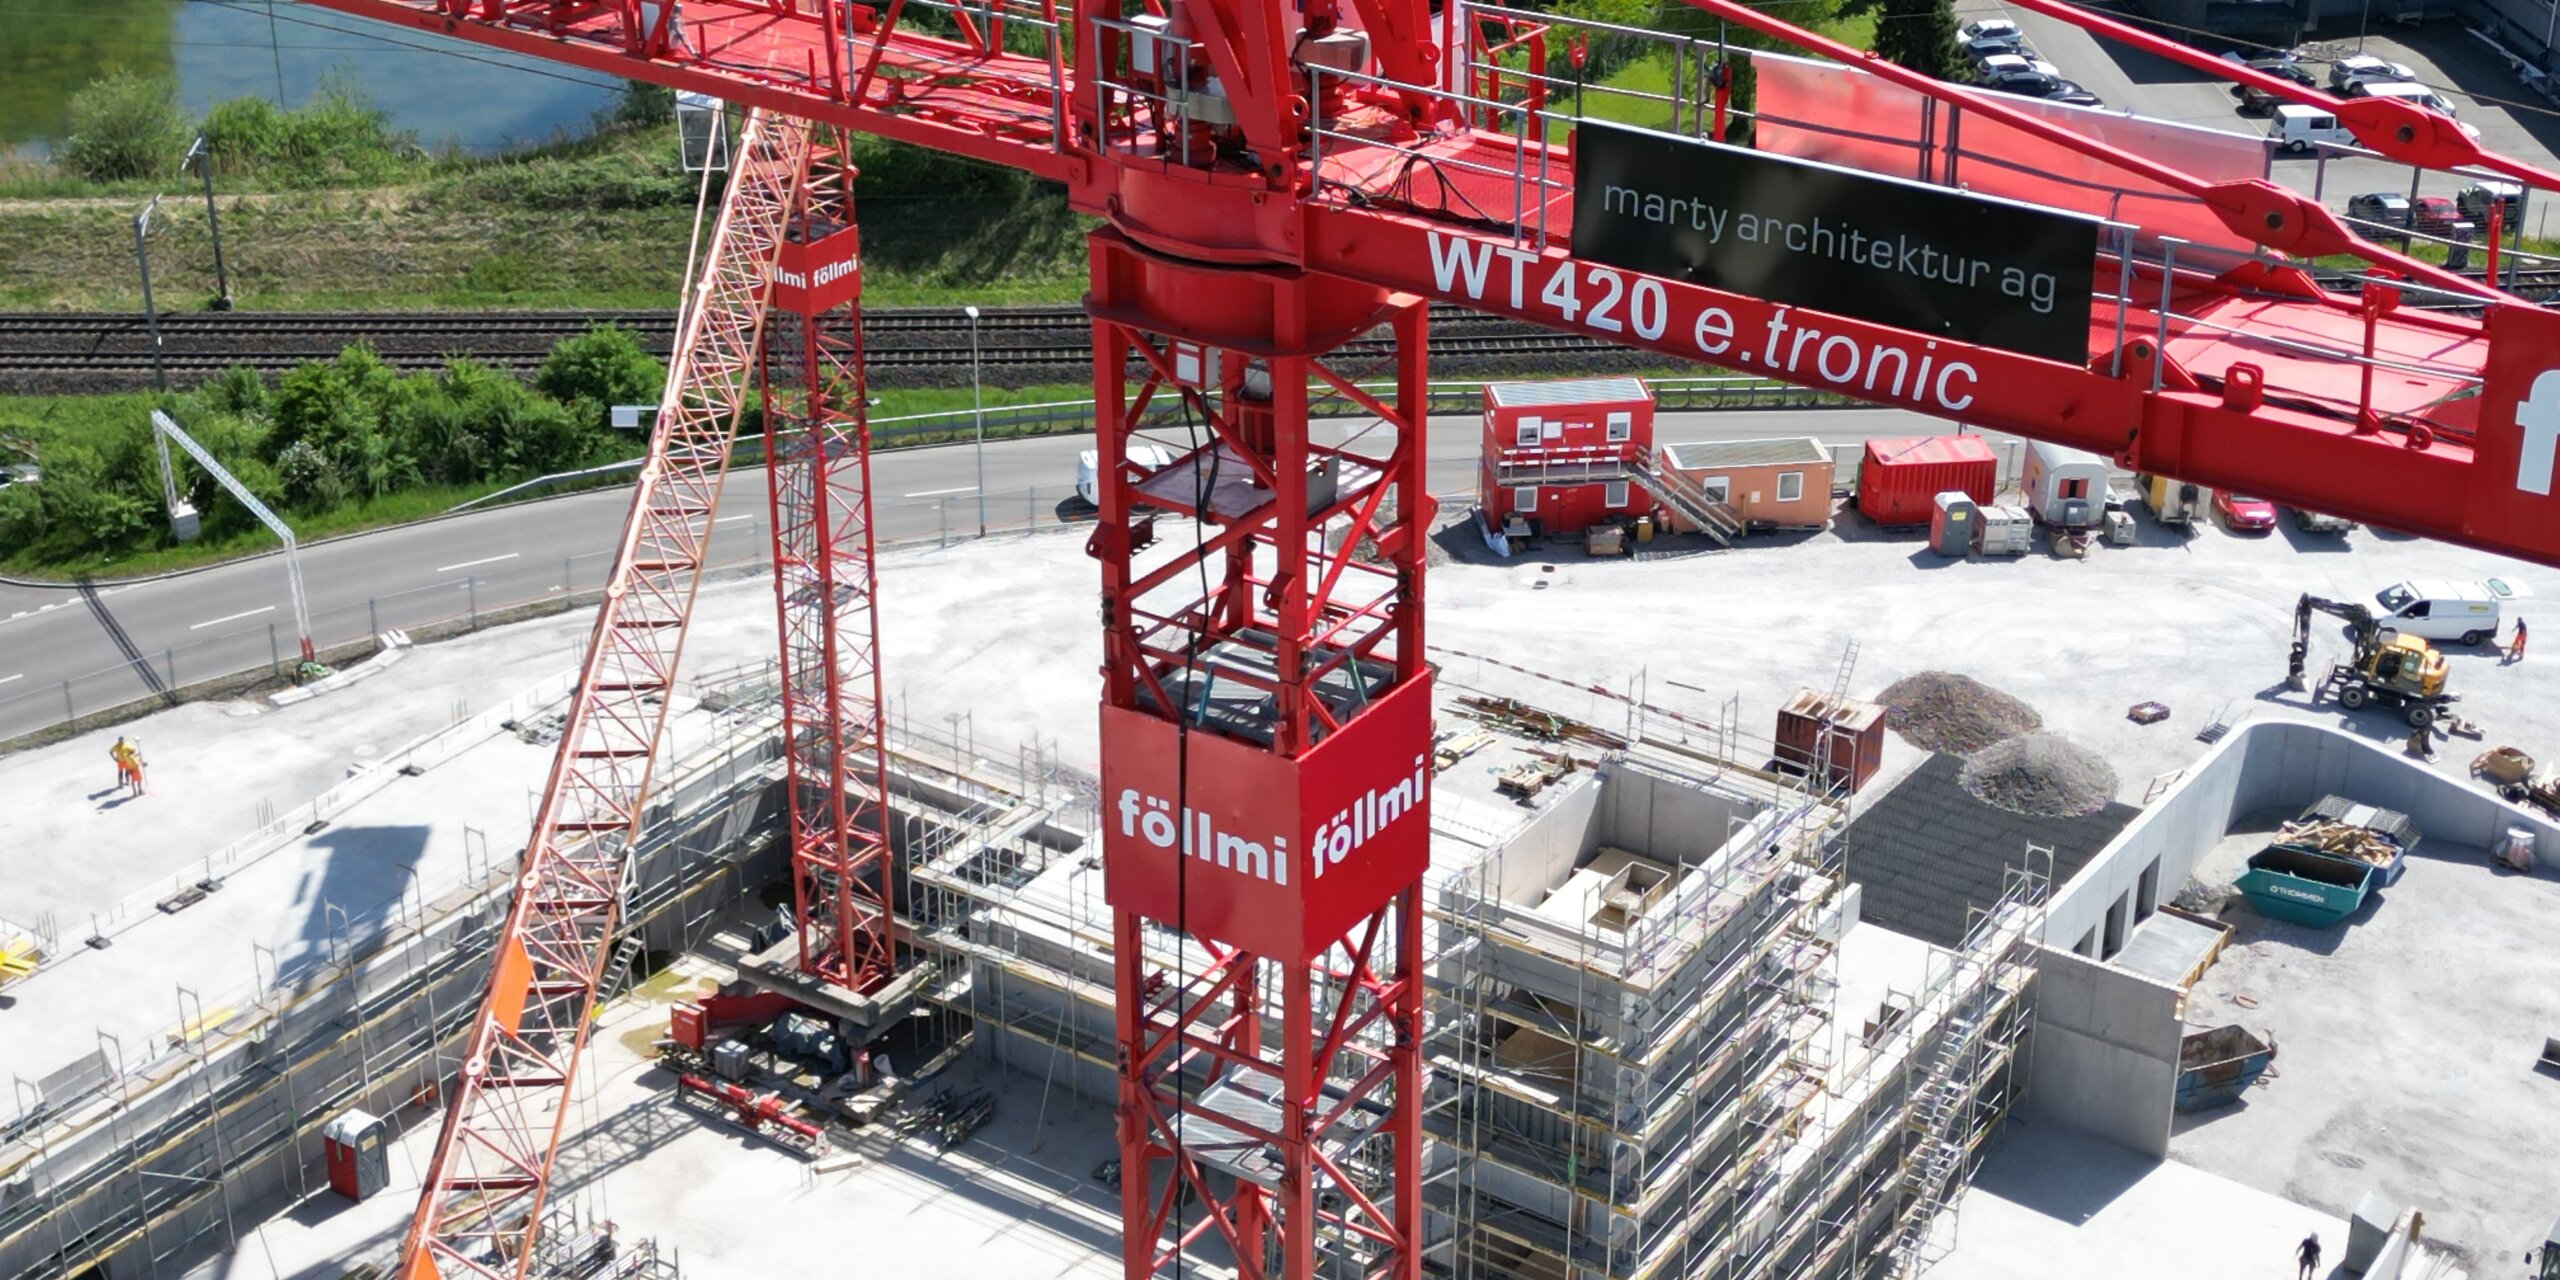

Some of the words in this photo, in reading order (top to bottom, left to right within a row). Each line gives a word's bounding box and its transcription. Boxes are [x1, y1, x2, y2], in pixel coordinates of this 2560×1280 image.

[812, 253, 858, 288] föllmi
[1604, 183, 1728, 245] marty
[1737, 210, 1990, 288] architektur
[2001, 264, 2056, 314] ag
[1427, 231, 1667, 340] WT420
[1694, 306, 1978, 411] e.tronic
[1118, 789, 1287, 886] föllmi
[1312, 753, 1424, 879] föllmi
